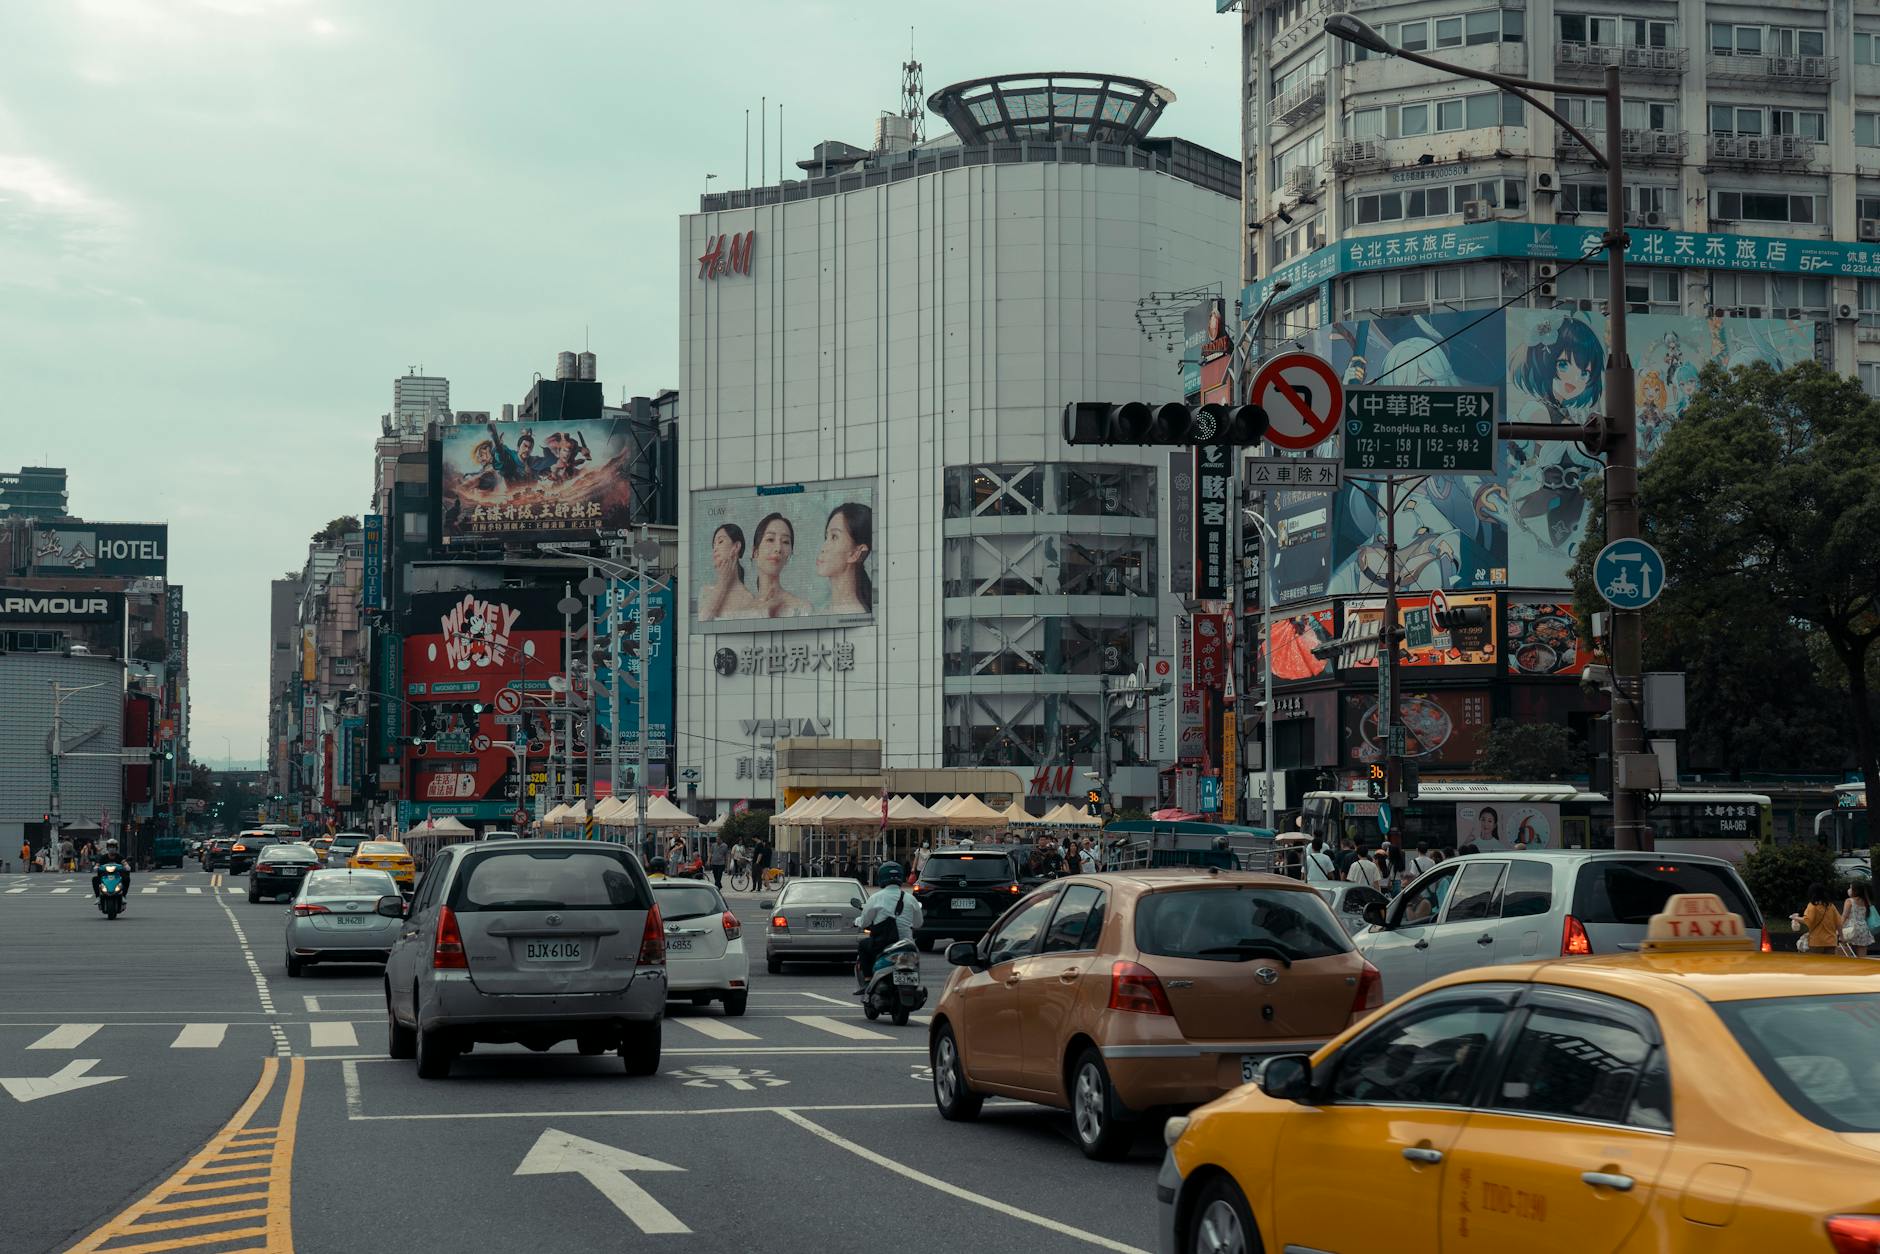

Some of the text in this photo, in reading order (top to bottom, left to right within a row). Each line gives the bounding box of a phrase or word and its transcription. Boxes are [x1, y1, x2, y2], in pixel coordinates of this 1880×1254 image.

[1350, 231, 1457, 260] 台北天禾旅店
[1457, 242, 1475, 256] 5F
[1625, 233, 1787, 262] 北天禾旅店
[697, 229, 754, 281] H&M
[1358, 251, 1449, 268] TAIPEI TIMHO HOTEL
[1632, 254, 1776, 269] TAIPEI TIMHO HOTEL
[1799, 255, 1822, 271] 5F
[1847, 250, 1868, 263] 休息
[1841, 263, 1852, 272] 02
[1363, 394, 1478, 417] 中華路一段
[1351, 422, 1359, 432] 3
[1373, 423, 1466, 436] ZhongHua Rd. Sec.1
[1480, 422, 1488, 432] 3
[1395, 438, 1412, 451] 158
[1426, 438, 1479, 452] 152 98-2
[1361, 455, 1410, 468] 59 55
[1442, 455, 1456, 468] 53
[1256, 465, 1334, 483] 公車除外
[1104, 487, 1119, 511] 5
[1201, 475, 1225, 526] 駭客
[98, 539, 165, 560] HOTEL
[367, 556, 378, 605] HOTEL
[1104, 567, 1119, 592] 4
[440, 594, 522, 642] MICKEY
[172, 610, 180, 649] HOTEL
[1226, 622, 1233, 637] 50
[445, 633, 506, 670] MOSE
[739, 641, 856, 676] 新世界大樓
[1104, 646, 1119, 671] 3
[1158, 726, 1167, 753] Salon
[736, 756, 775, 780] 真善
[1370, 764, 1384, 779] 36
[1029, 765, 1074, 797] H&M
[1088, 790, 1100, 804] 36
[1704, 804, 1757, 817] 大都會客運
[1719, 819, 1747, 832] FAA-063
[1667, 919, 1738, 937] TAXI
[527, 943, 581, 959] BJX-6106
